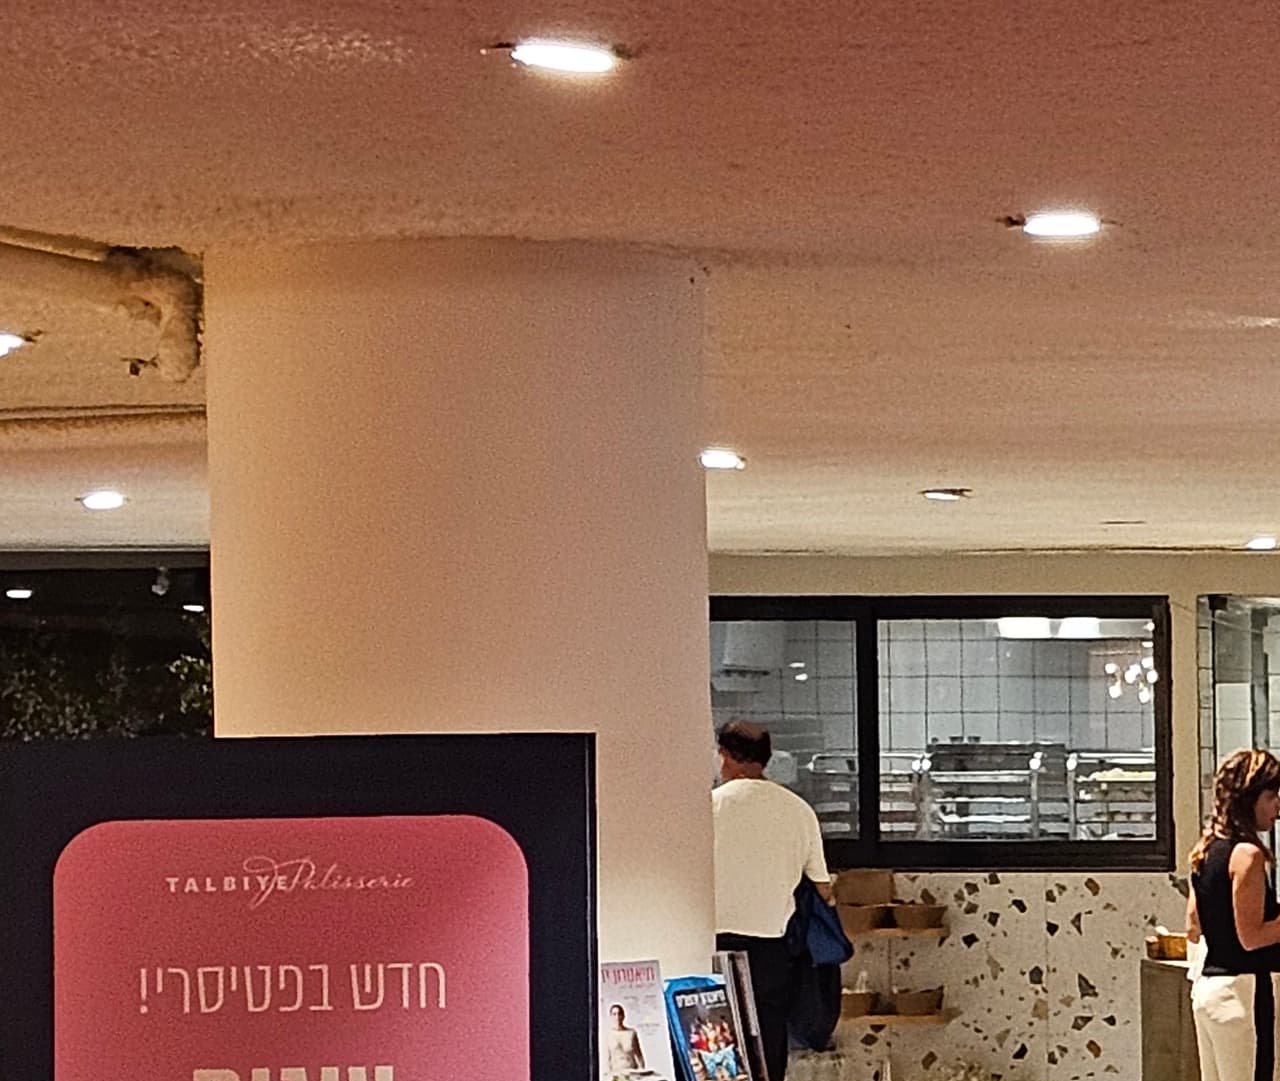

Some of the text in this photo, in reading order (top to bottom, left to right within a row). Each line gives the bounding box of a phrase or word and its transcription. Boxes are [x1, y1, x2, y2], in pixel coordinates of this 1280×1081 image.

[165, 876, 288, 893] TALBIYE
[139, 962, 446, 1014] חדש בפטיסרי!
